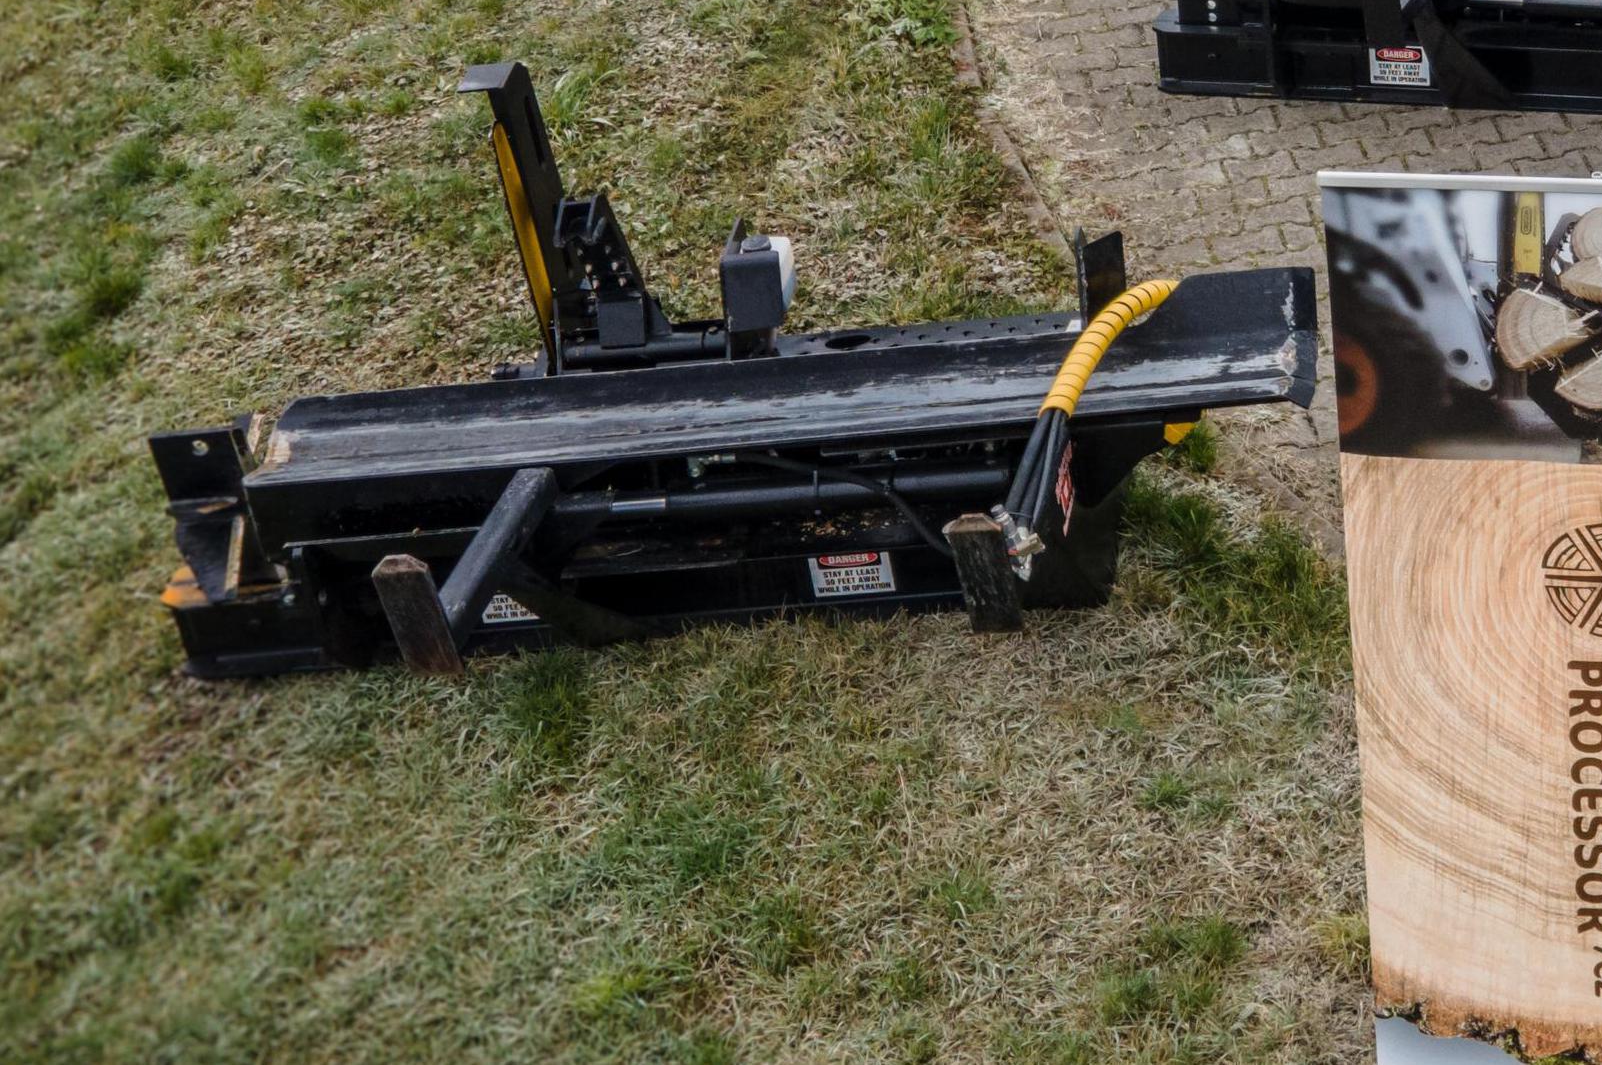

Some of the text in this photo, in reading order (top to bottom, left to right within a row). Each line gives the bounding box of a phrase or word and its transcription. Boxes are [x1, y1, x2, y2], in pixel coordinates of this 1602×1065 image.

[1383, 50, 1414, 60] DANGER
[827, 553, 869, 564] DANGER
[851, 582, 891, 591] OPERATION
